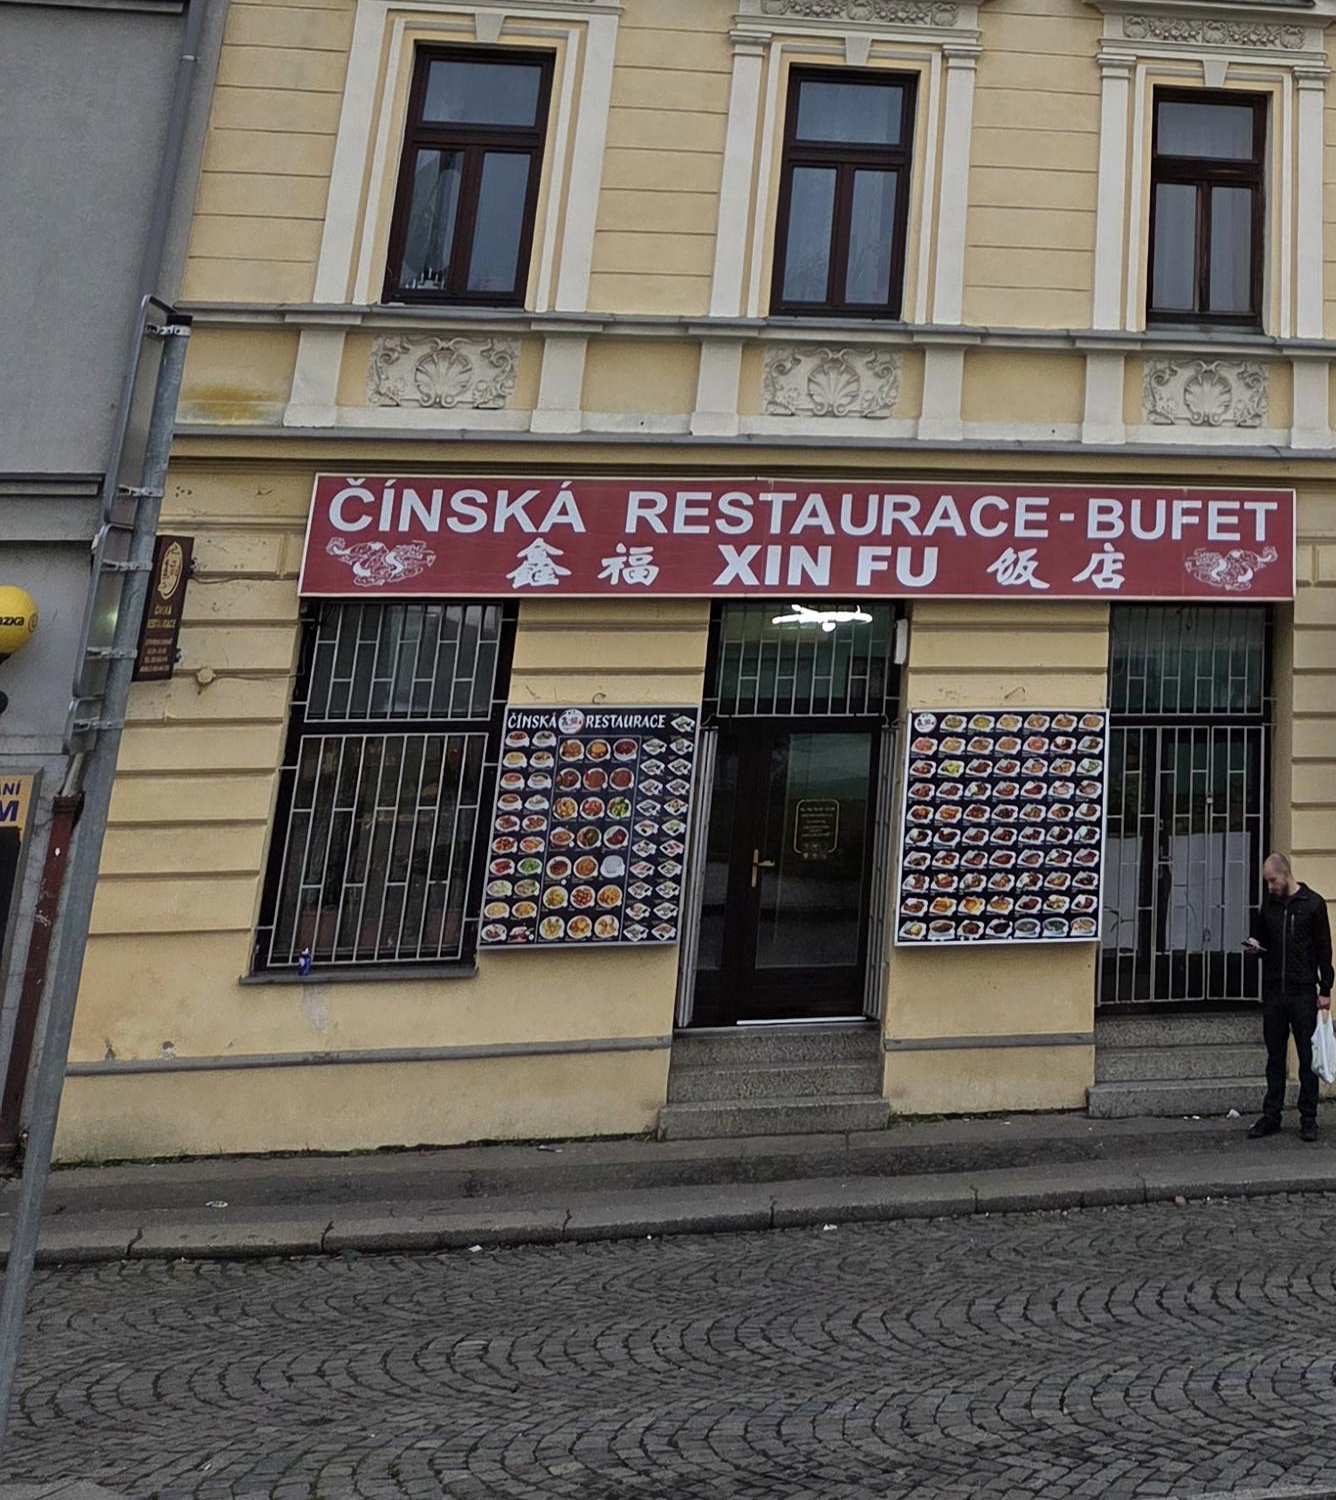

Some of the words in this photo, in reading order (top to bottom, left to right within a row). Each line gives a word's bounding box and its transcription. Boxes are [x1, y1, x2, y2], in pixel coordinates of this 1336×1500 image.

[328, 477, 587, 534] ČÍNSKÁ
[713, 544, 832, 587] XIN
[856, 545, 939, 588] FU
[507, 710, 557, 730] ČÍNSKÁ
[585, 713, 667, 729] RESTAURACE
[0, 780, 22, 796] NÍ
